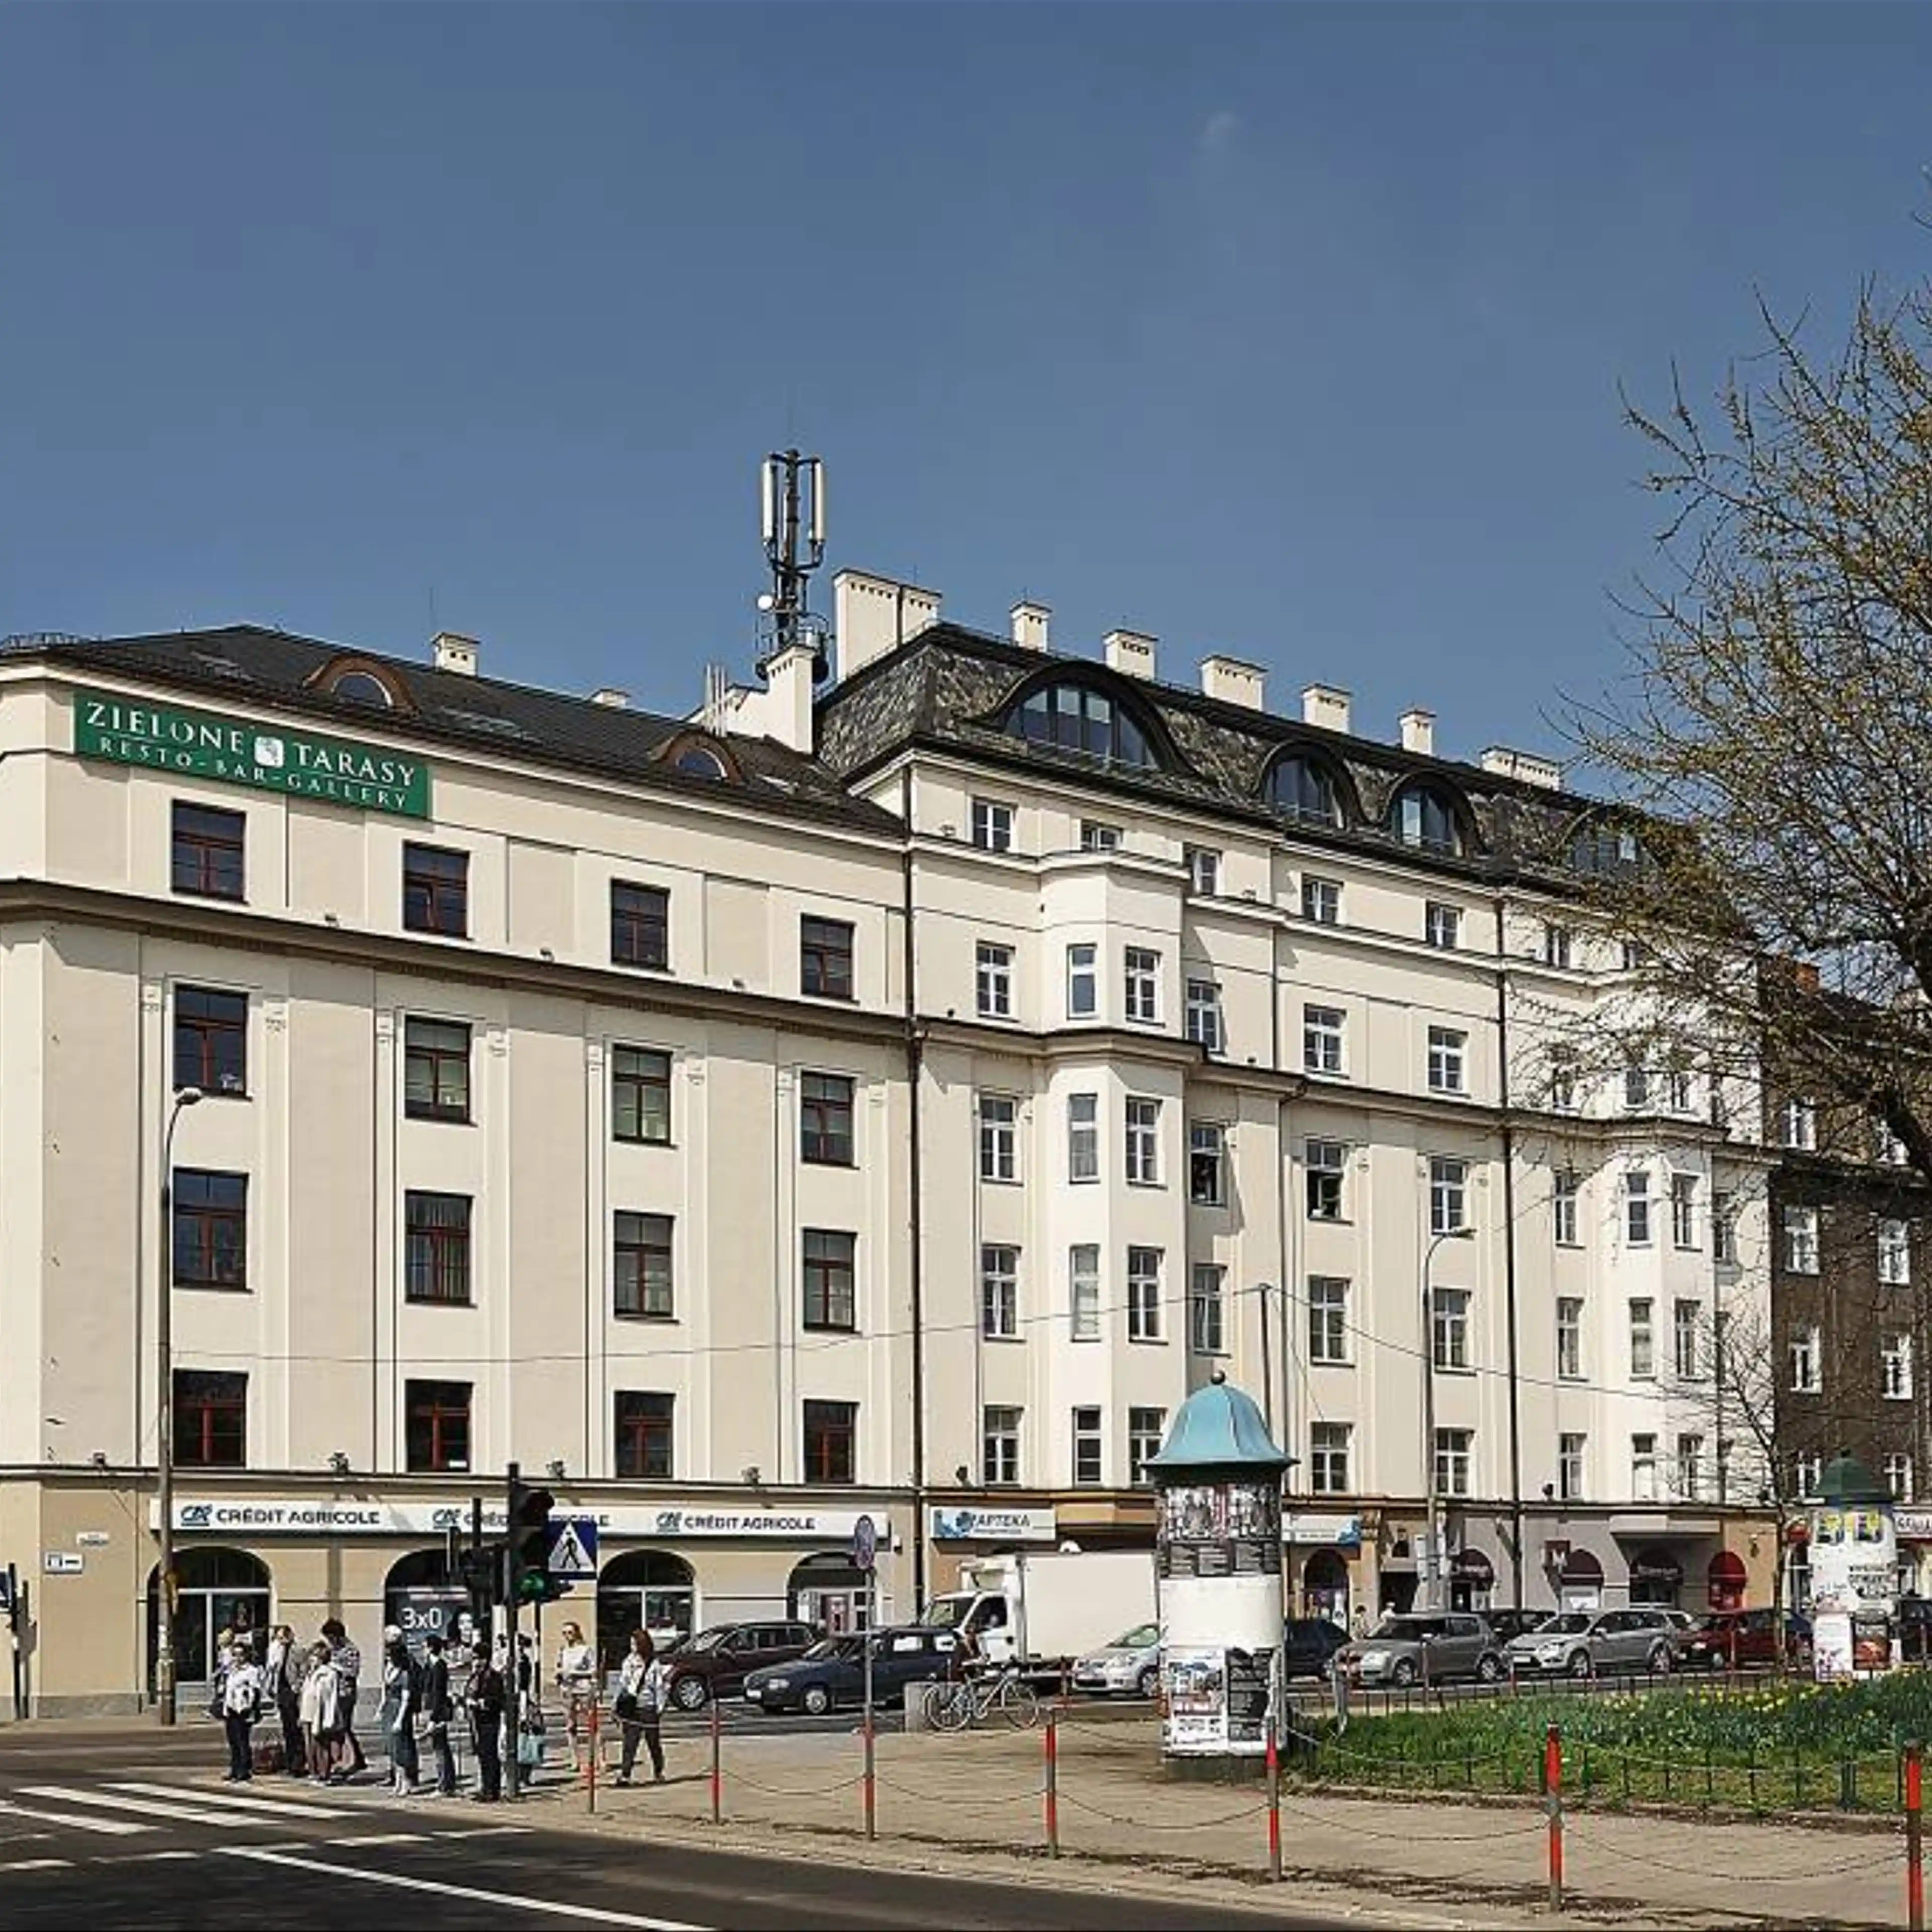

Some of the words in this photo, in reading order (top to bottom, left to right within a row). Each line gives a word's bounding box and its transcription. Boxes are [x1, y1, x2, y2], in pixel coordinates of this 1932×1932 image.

[87, 702, 245, 754] ZIELONE
[293, 742, 414, 786] TARASY
[216, 1504, 287, 1523] CRÉDIT
[288, 1511, 380, 1524] AGRICOLE
[684, 1515, 740, 1528] CRÉDIT
[741, 1517, 816, 1530] AGRICOLE
[977, 1514, 1030, 1527] APTEKA
[401, 1606, 442, 1629] 3x0
